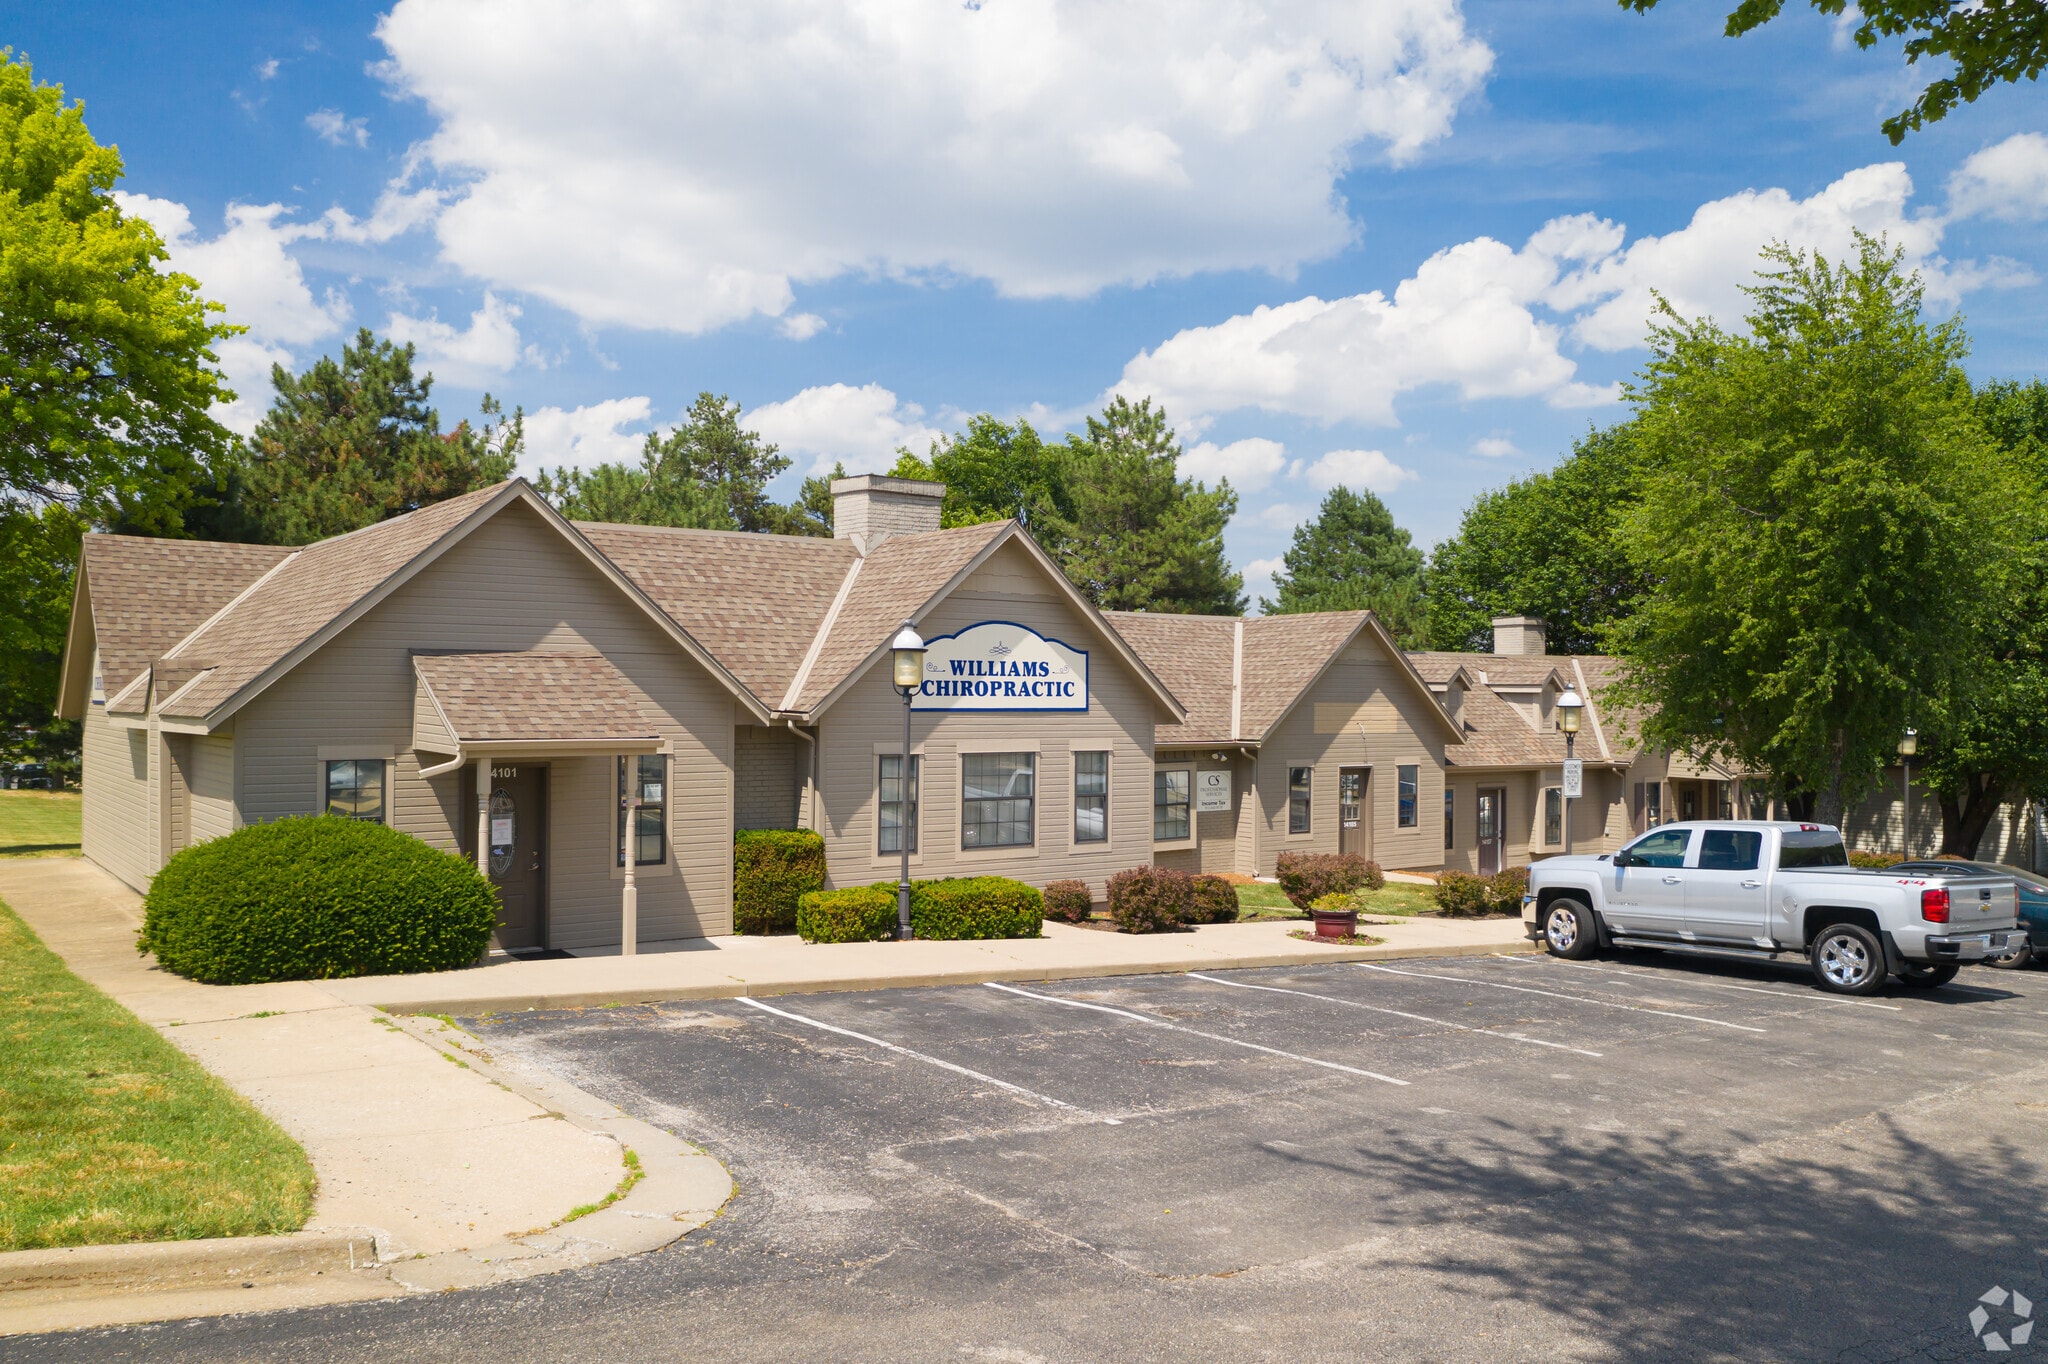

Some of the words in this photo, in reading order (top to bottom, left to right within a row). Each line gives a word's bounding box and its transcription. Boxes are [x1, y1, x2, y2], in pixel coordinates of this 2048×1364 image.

[950, 660, 1049, 677] WILLIAMS
[922, 680, 1075, 697] CHIROPRACTIC
[1208, 775, 1220, 786] CS
